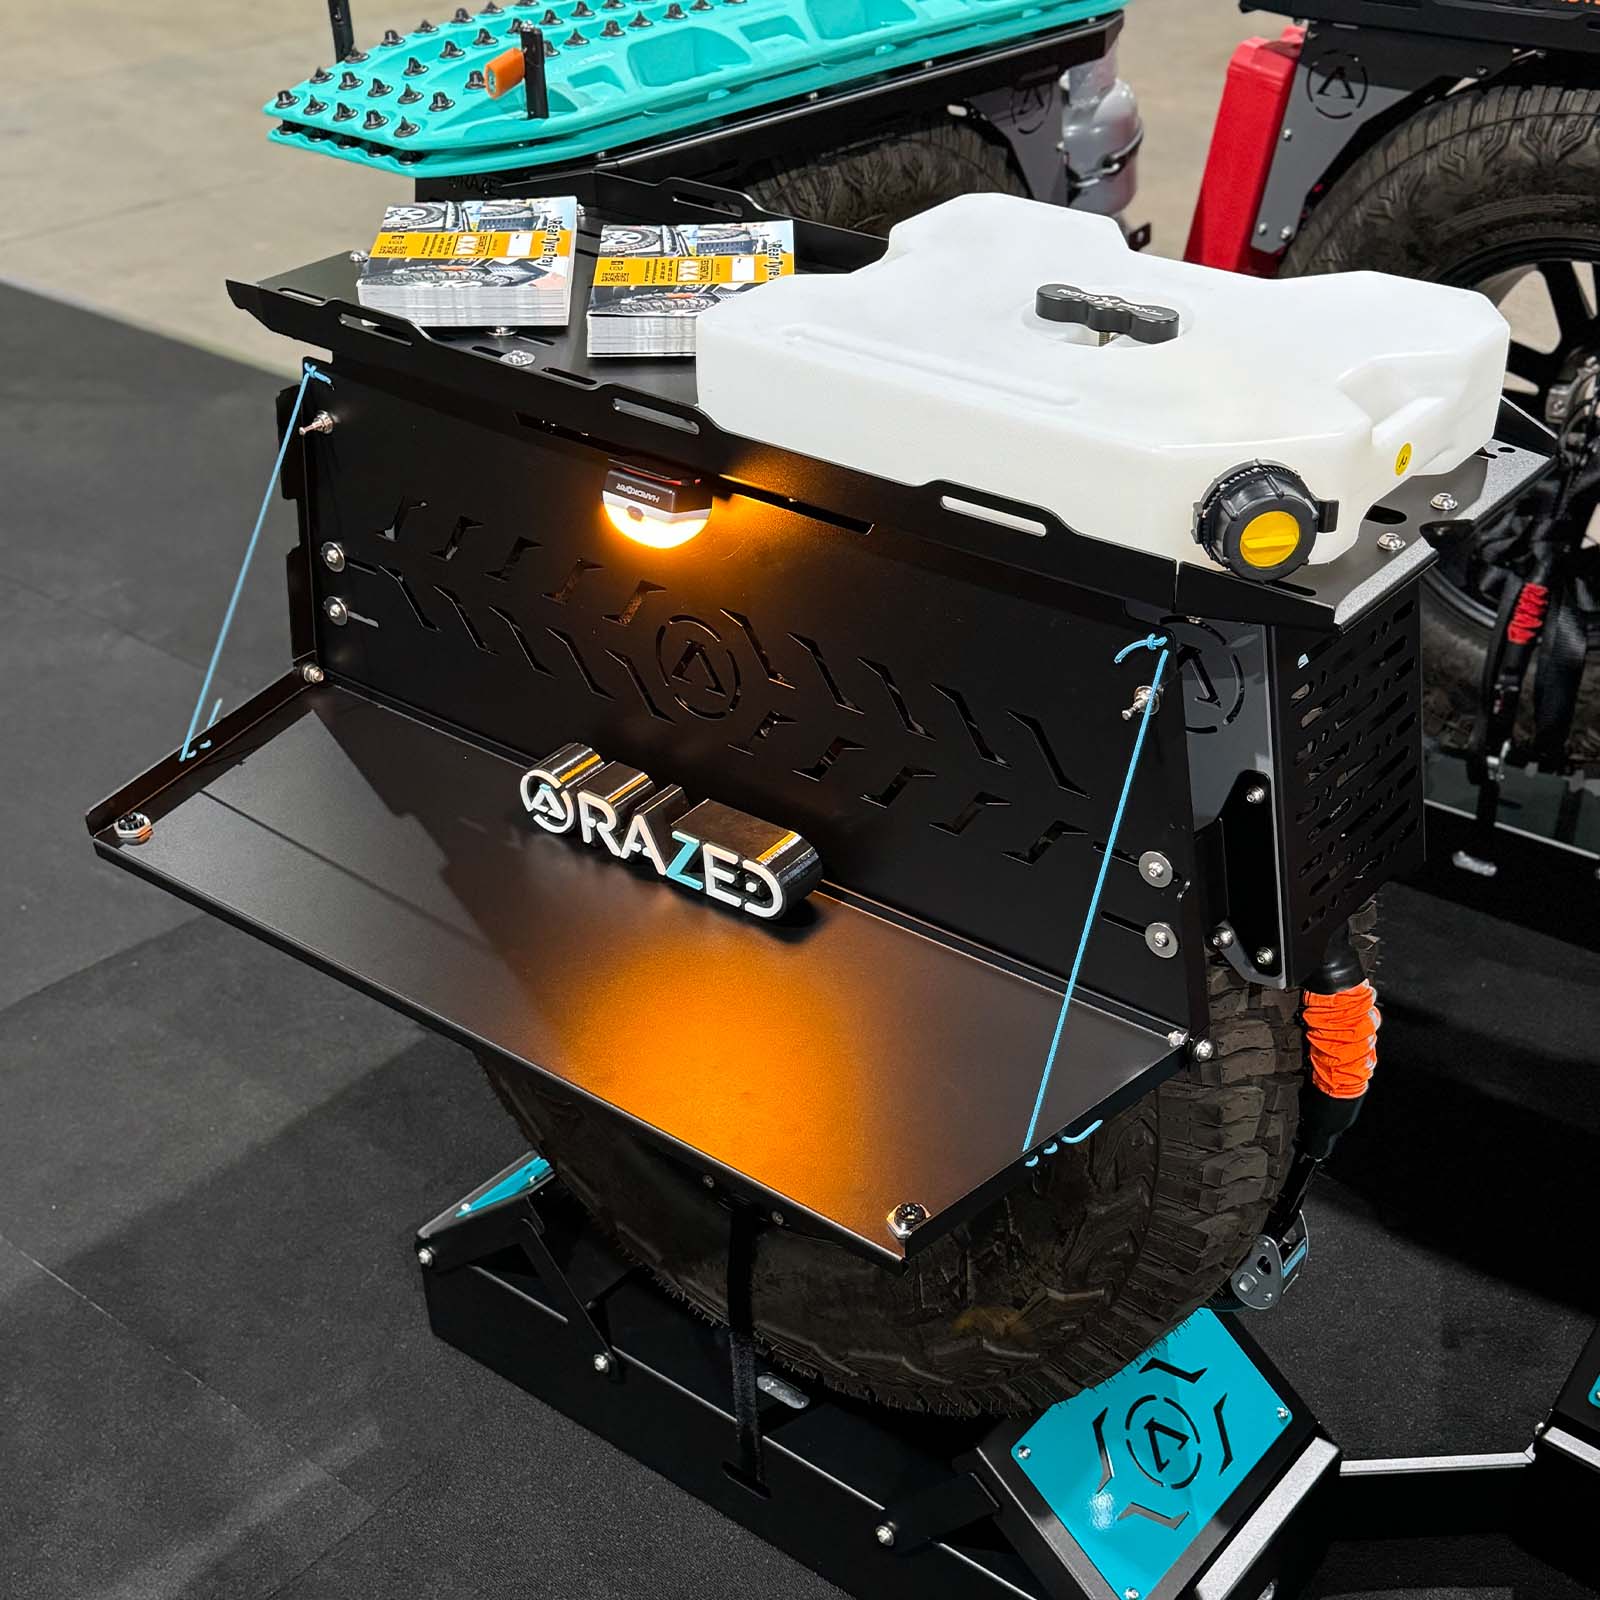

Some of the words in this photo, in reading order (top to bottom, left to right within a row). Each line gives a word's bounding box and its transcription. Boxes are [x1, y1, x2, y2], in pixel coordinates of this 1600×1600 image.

[546, 216, 563, 236] Rear
[541, 237, 561, 253] Tyre
[767, 243, 783, 260] Rear
[536, 253, 558, 268] Tray
[763, 260, 783, 276] Tyre
[576, 790, 784, 920] RAZED
